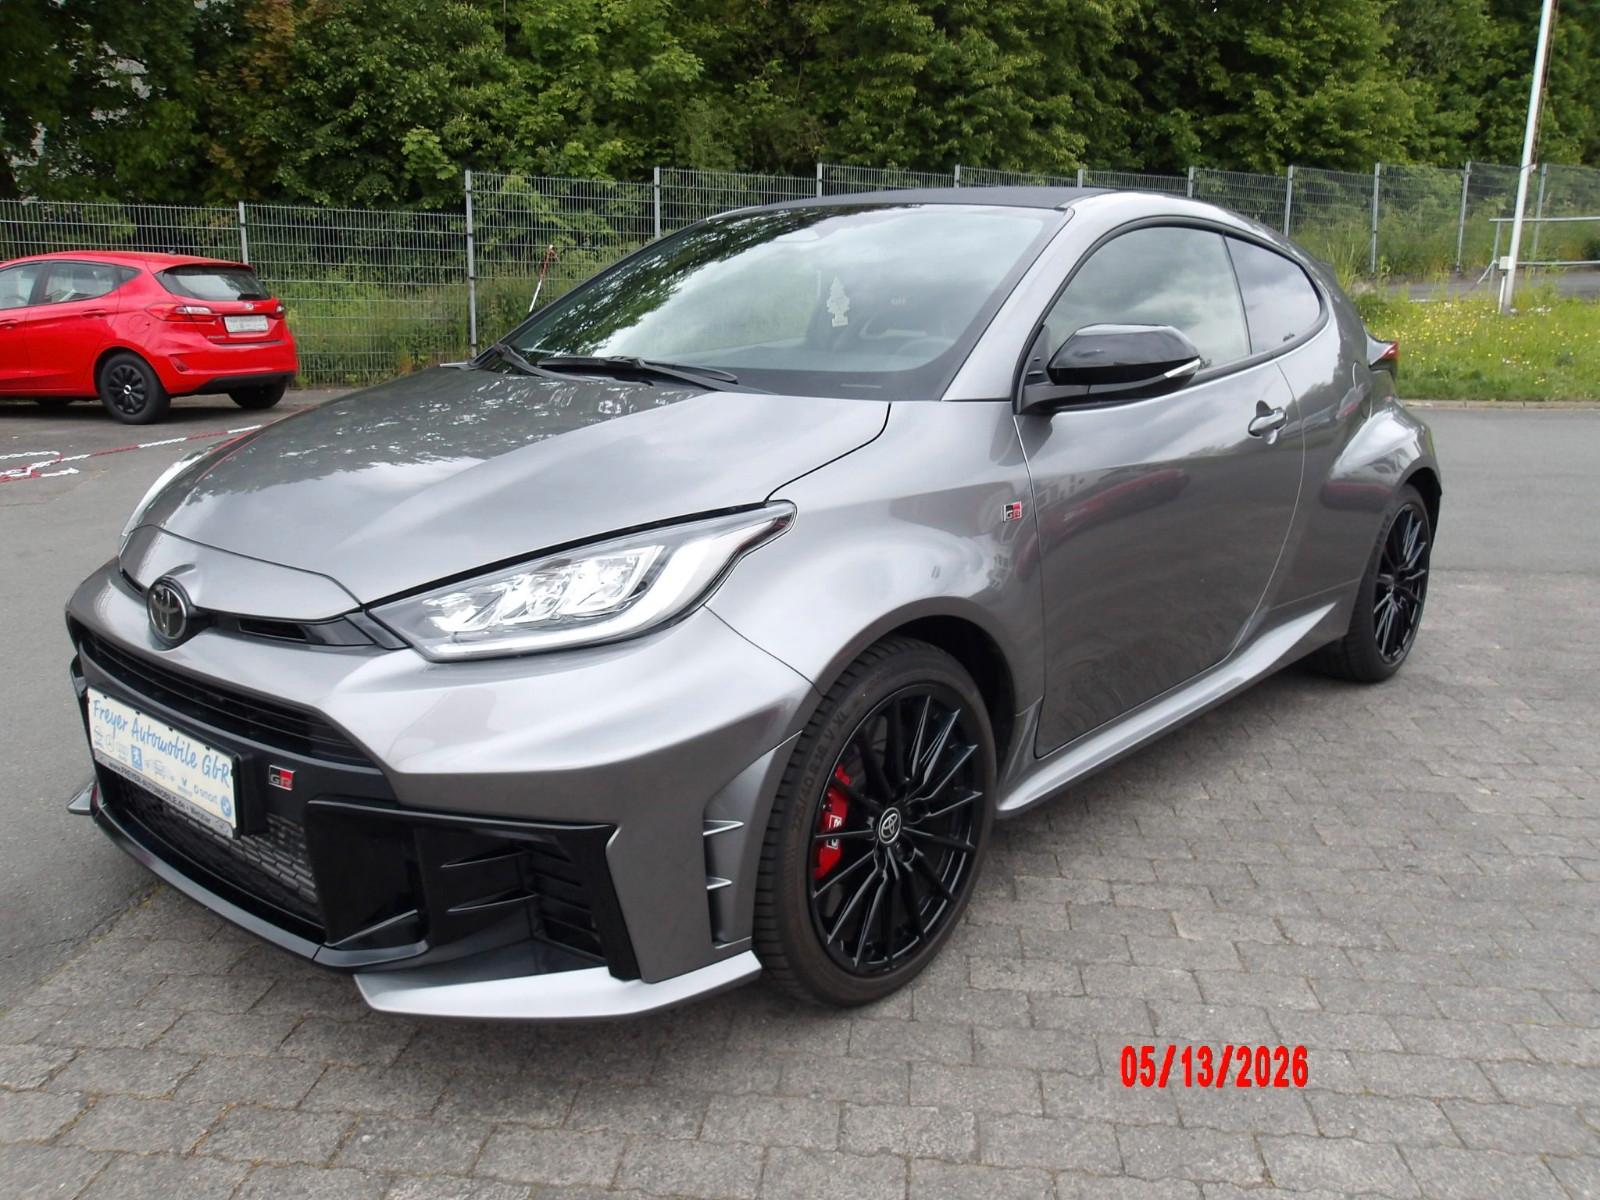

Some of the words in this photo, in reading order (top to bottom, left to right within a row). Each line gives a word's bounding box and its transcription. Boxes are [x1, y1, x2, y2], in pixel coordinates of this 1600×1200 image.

[94, 700, 128, 738] Freyer
[132, 717, 198, 768] Automobile
[202, 754, 230, 788] GbR
